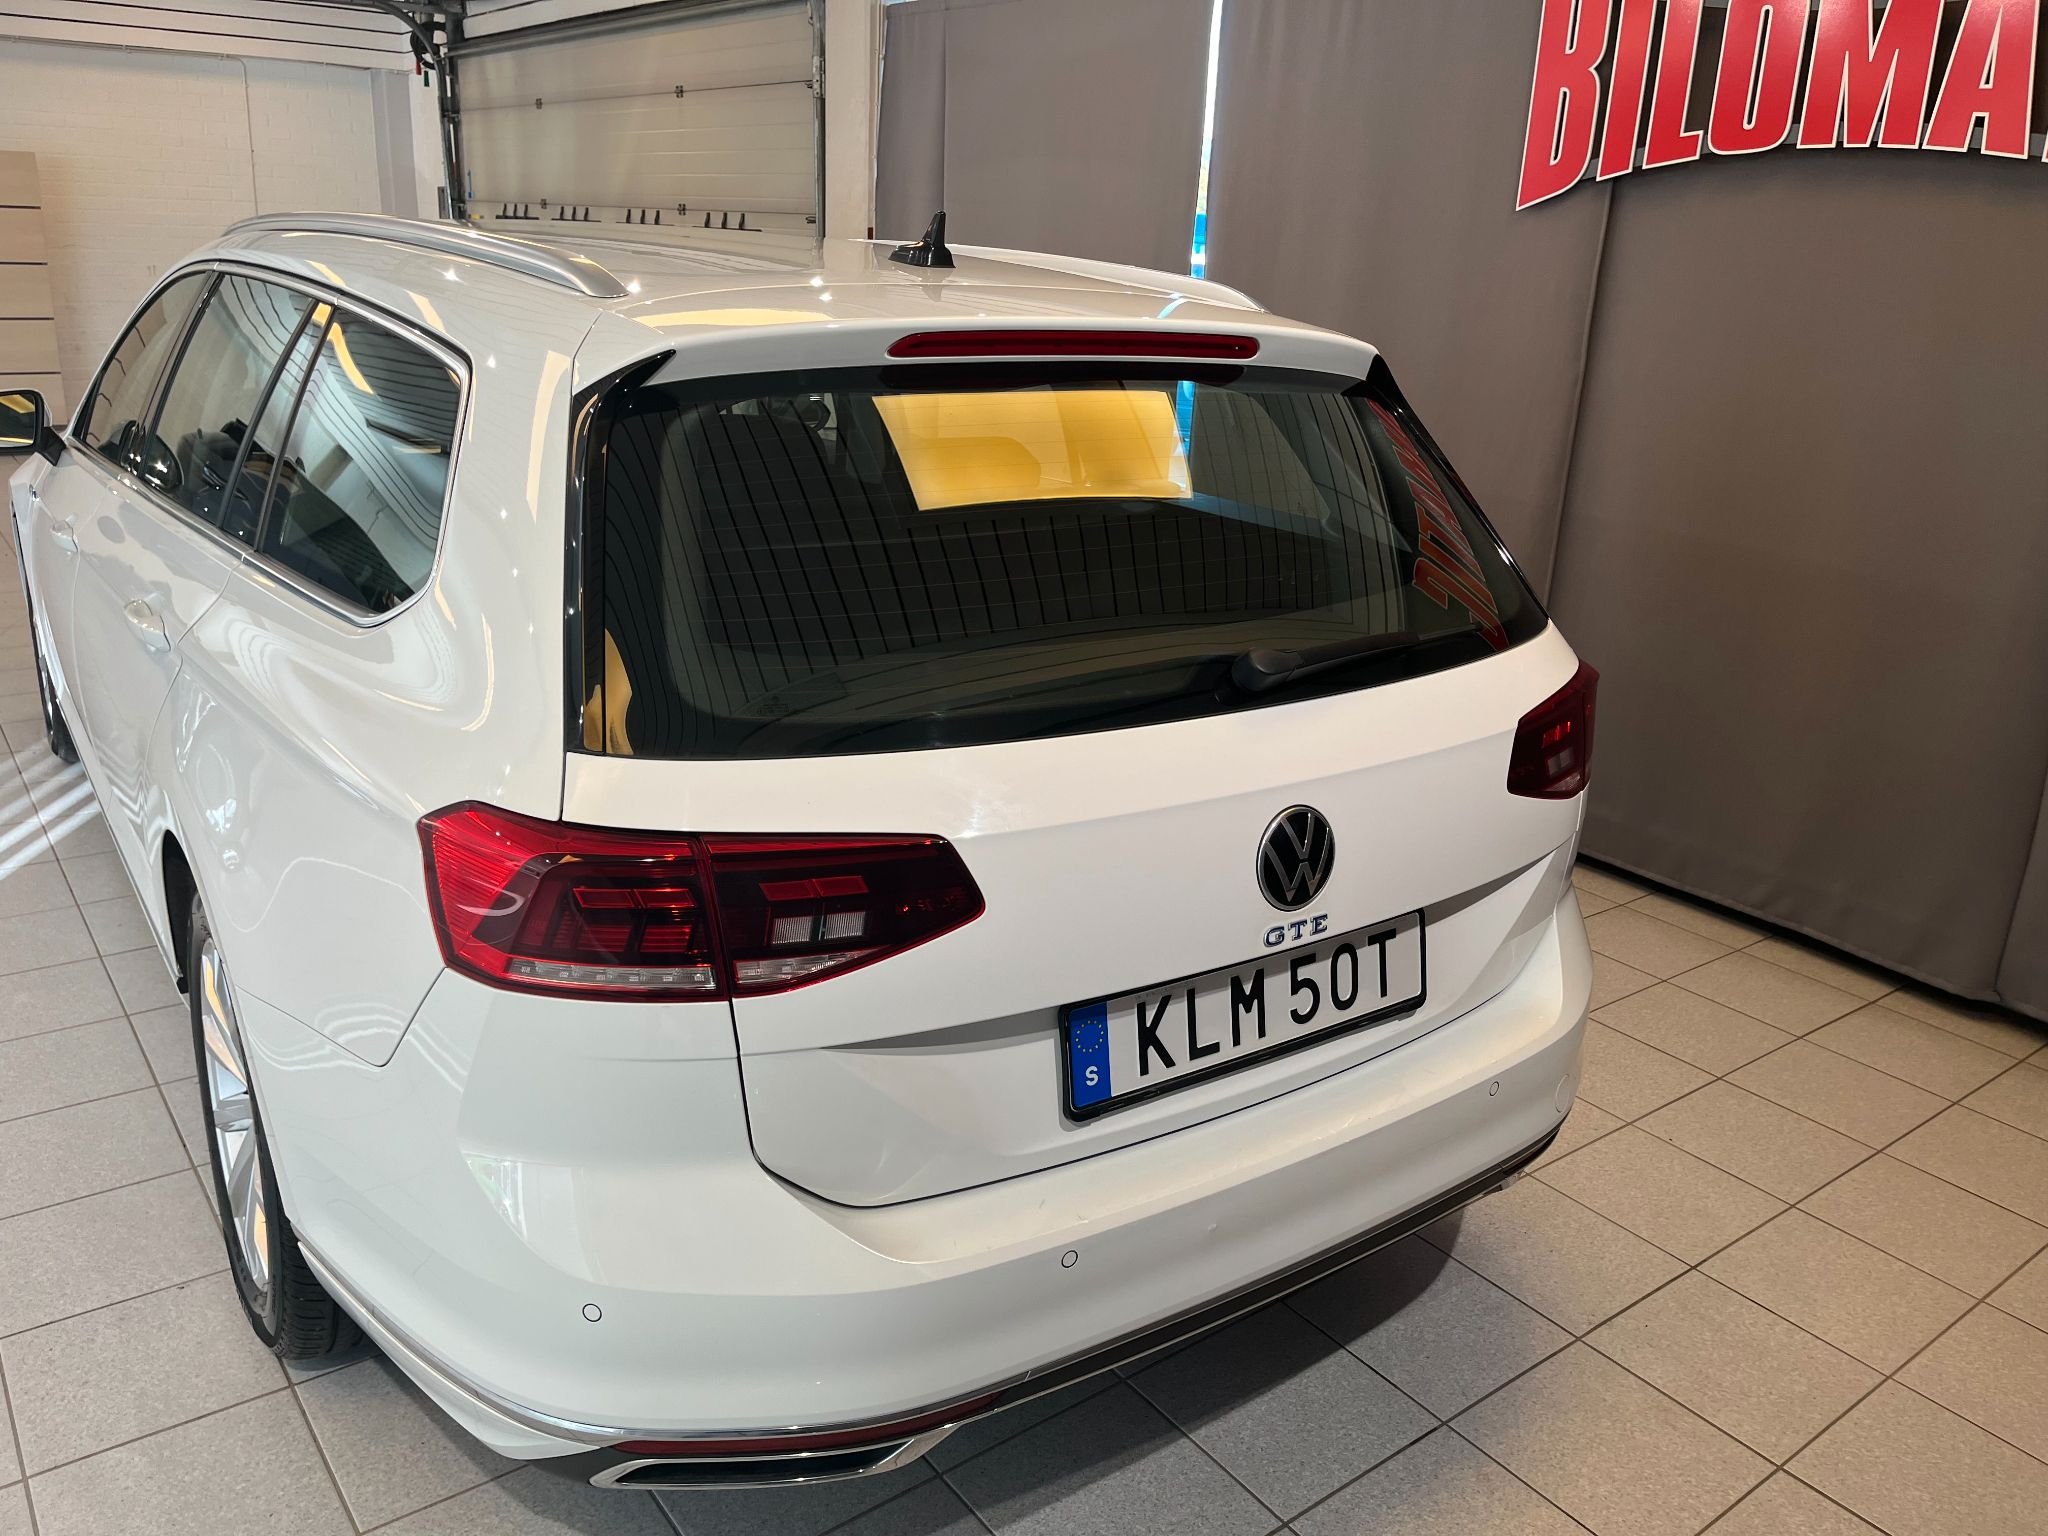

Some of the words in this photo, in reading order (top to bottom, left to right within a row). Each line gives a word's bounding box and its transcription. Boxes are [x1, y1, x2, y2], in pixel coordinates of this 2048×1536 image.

[1516, 0, 2048, 211] BILOMA
[1262, 913, 1329, 947] GTE
[1135, 968, 1267, 1077] KLM
[1289, 928, 1397, 1025] 50T
[1084, 1064, 1100, 1087] S
